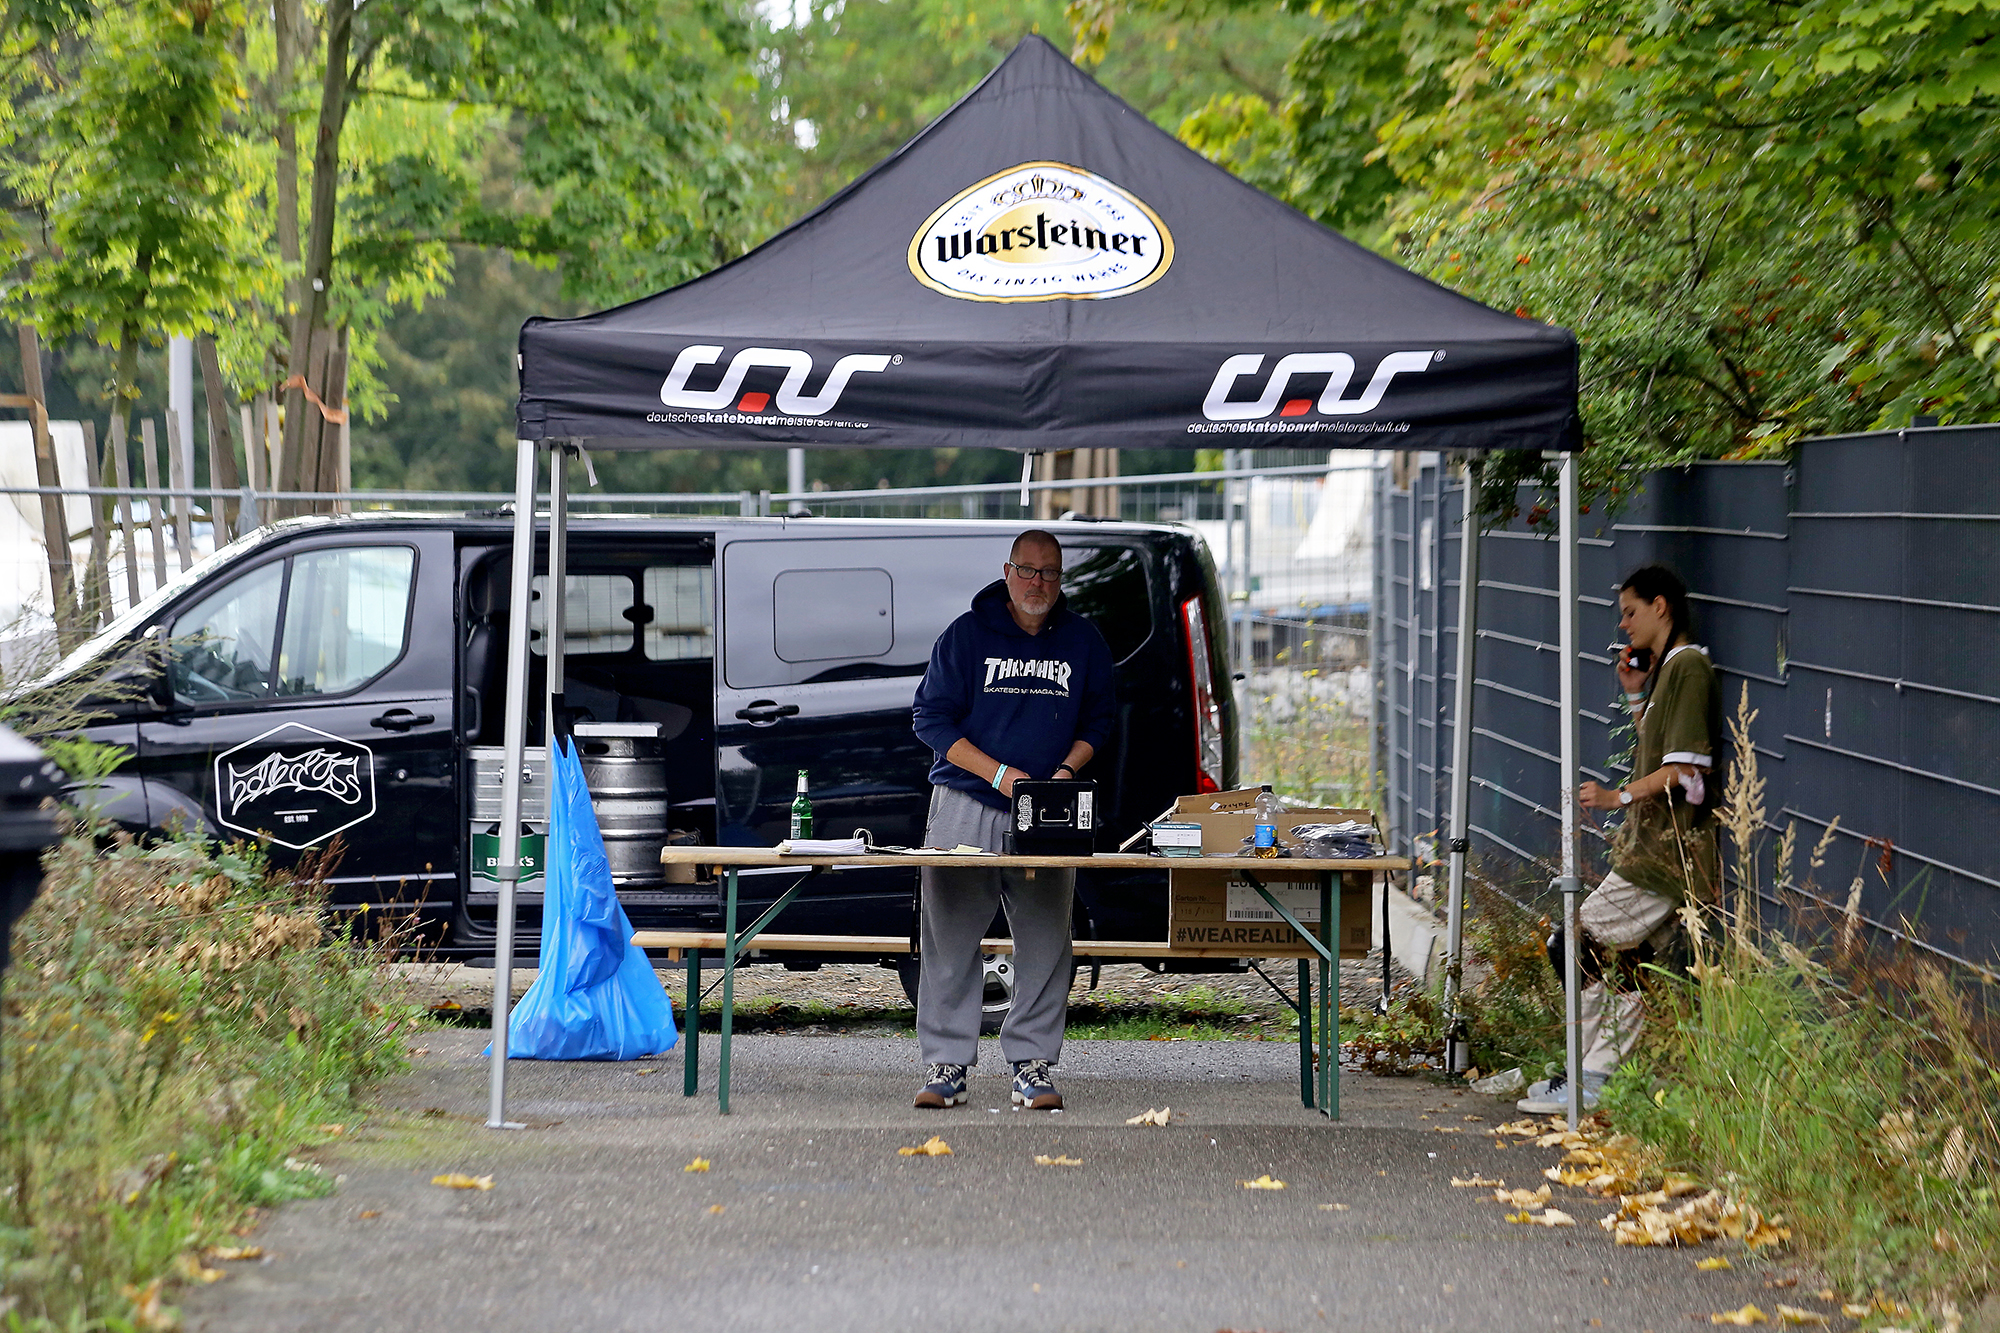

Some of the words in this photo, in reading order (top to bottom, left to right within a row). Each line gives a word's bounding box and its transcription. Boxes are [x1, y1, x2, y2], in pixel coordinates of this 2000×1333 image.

[936, 212, 1148, 263] Warsteiner
[1187, 420, 1411, 434] deutscheskateboardmeisterschaft.de
[984, 657, 1072, 692] THRAHER
[486, 855, 536, 868] BK'S
